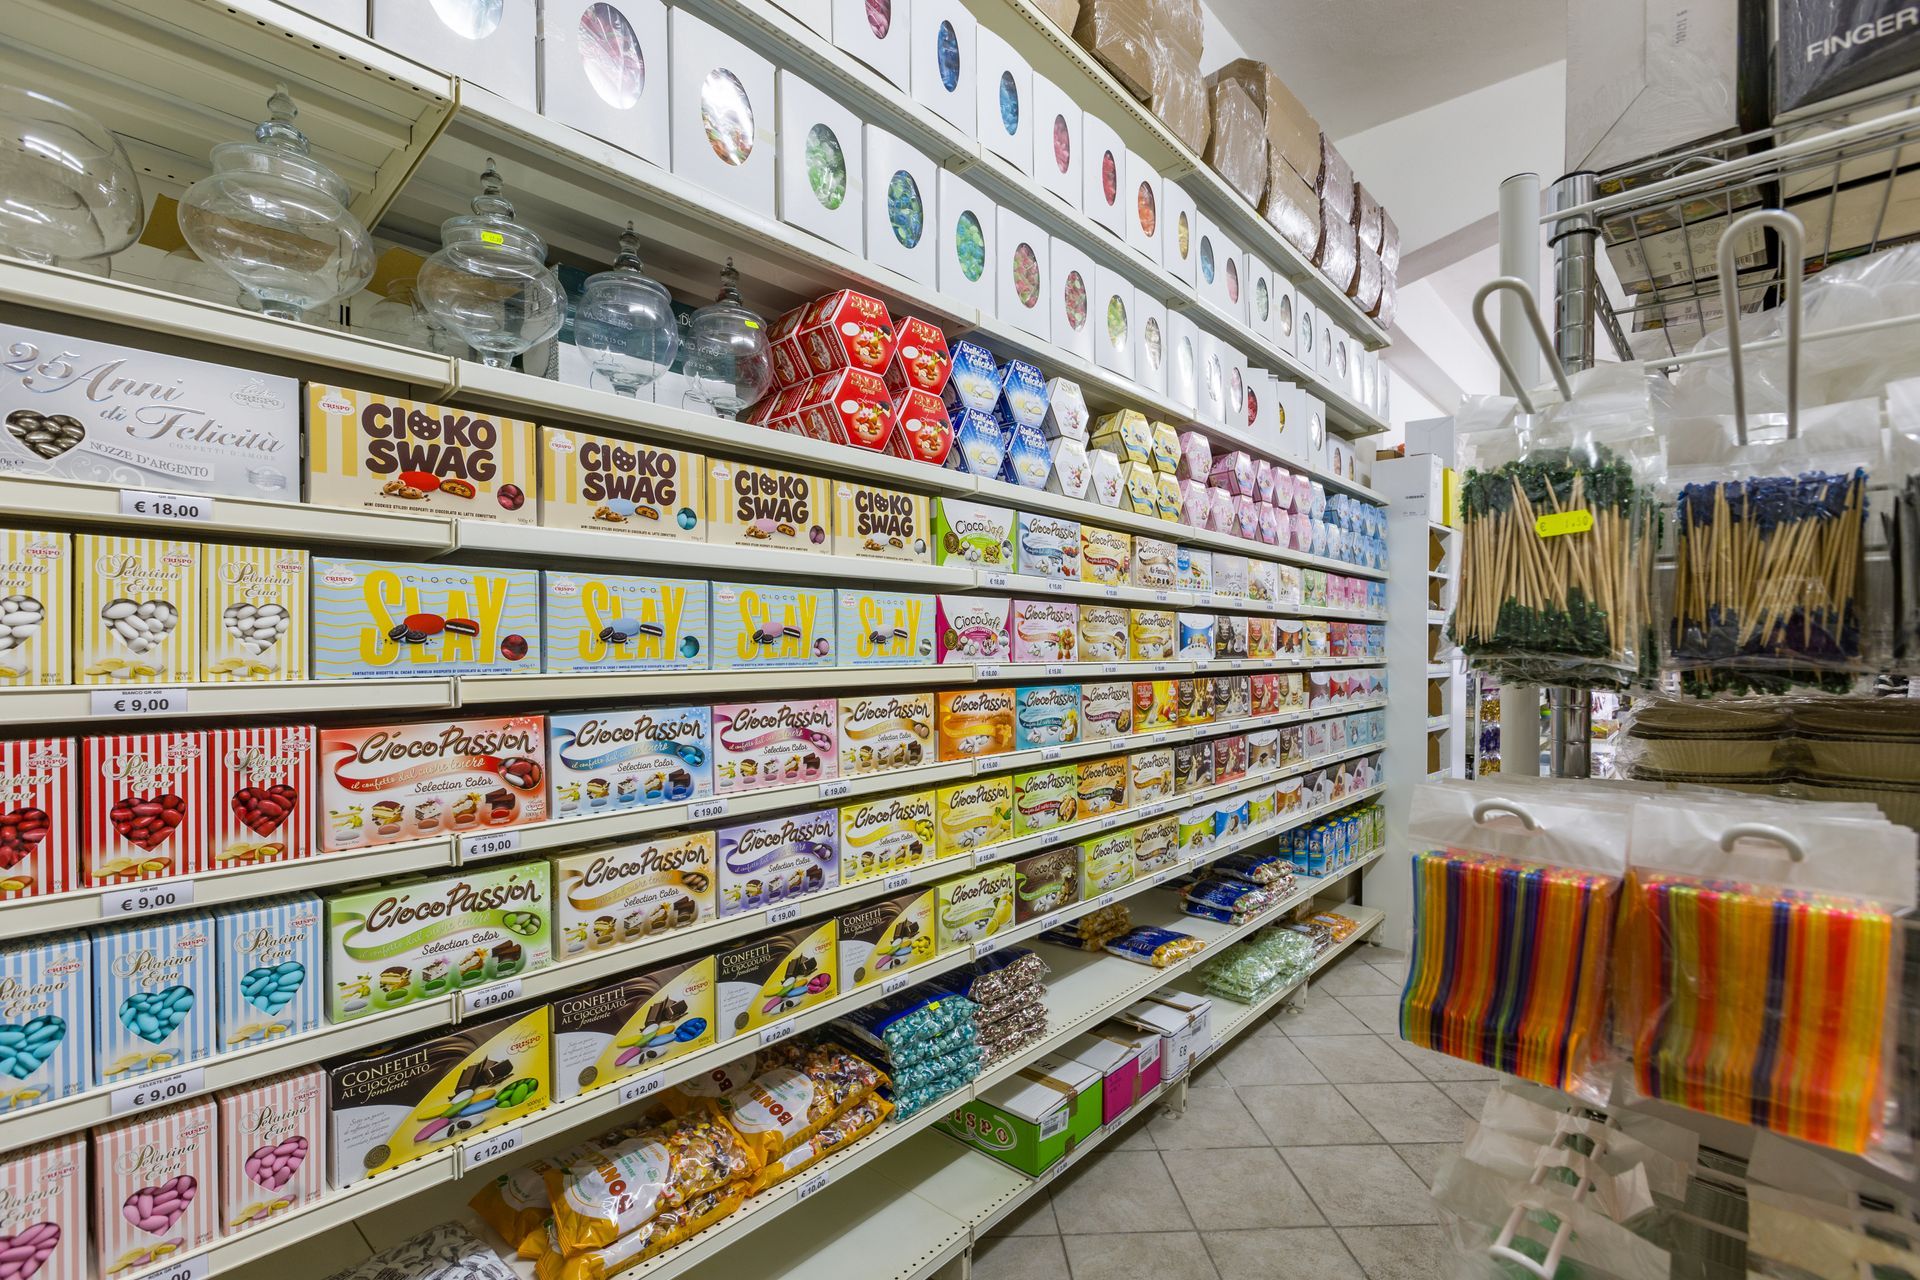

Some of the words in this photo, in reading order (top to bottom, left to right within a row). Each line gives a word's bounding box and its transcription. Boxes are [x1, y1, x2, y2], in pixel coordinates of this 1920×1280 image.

[1807, 7, 1919, 62] FINGER
[2, 342, 80, 379] 25
[22, 358, 185, 402] Anni
[322, 402, 350, 411] CRISPO
[100, 404, 127, 422] di
[126, 404, 285, 453] Felicità
[361, 403, 497, 450] CIOKO
[90, 440, 133, 461] NOZZE
[136, 453, 209, 478] D'ARGENTO
[365, 439, 497, 482] SWAG
[580, 442, 677, 479] CIOKO
[582, 472, 677, 506] SWAG
[734, 470, 809, 500] CIOKO
[134, 501, 146, 513] €
[152, 502, 199, 518] 18,00
[736, 496, 809, 524] SWAG
[855, 490, 914, 517] CIOKO
[857, 513, 914, 537] SWAG
[1029, 517, 1079, 542] CiocoPassion
[1089, 531, 1129, 551] CiocoPassion
[97, 554, 180, 579] Pelatina
[219, 561, 291, 585] Pelatina
[117, 580, 165, 592] Etna
[406, 575, 468, 585] CIOCO
[244, 585, 278, 597] Etna
[360, 570, 508, 666] SLAY
[578, 581, 687, 662] SLAY
[954, 612, 1001, 630] CiocoSoft
[1024, 604, 1076, 625] CiocoPassion
[1087, 608, 1127, 627] CiocoPassion
[1139, 610, 1174, 627] CiocoPassion
[737, 589, 817, 661] SLAY
[857, 596, 921, 658] SLAY
[1026, 688, 1079, 707] CiocoPassion
[1090, 683, 1130, 701] CiocoPassion
[114, 700, 126, 712] €
[131, 699, 170, 714] 9,00
[854, 698, 930, 722] CiocoPassion
[952, 693, 1013, 712] CiocoPassion
[733, 704, 831, 731] CiocoPassion
[576, 714, 704, 747] CiocoPassion
[358, 724, 536, 764] CiocoPassion
[764, 744, 790, 755] Selection
[791, 742, 808, 751] Color
[102, 753, 187, 780] Pelatina
[225, 746, 299, 771] Pelatina
[617, 761, 652, 772] Selection
[654, 759, 674, 768] Color
[1137, 752, 1171, 771] CiocoPassion
[250, 771, 286, 782] Etna
[1082, 761, 1126, 781] CiocoPassion
[131, 780, 172, 792] Etna
[362, 775, 397, 791] confetto
[415, 780, 462, 793] Selection
[465, 776, 493, 788] Color
[830, 786, 847, 795] 19,00
[1024, 772, 1076, 793] CiocoPassion
[950, 784, 1010, 809] CiocoPassion
[702, 806, 723, 817] 19,00
[854, 798, 932, 828] CiocoPassion
[738, 816, 834, 854] CiocoPassion
[1140, 821, 1178, 844] CiocoPassion
[471, 845, 478, 854] €
[482, 840, 511, 852] 19,00
[1092, 837, 1133, 860] CiocoPassion
[584, 841, 709, 887] CiocoPassion
[769, 862, 794, 873] Selection
[796, 857, 811, 868] Color
[894, 878, 908, 888] 19,00
[951, 872, 1014, 905] CiocoPassion
[121, 899, 133, 911] €
[138, 893, 176, 911] 9,00
[366, 874, 542, 932] CiocoPassion
[624, 894, 657, 908] Selection
[660, 888, 679, 900] Color
[292, 917, 317, 927] CRISPO
[778, 909, 796, 921] 19,00
[843, 908, 881, 926] CONFETTI
[851, 918, 882, 933] CIOCCOLATO
[177, 937, 207, 949] CRISPO
[235, 927, 306, 954] Pelatina
[422, 939, 469, 956] Selection
[472, 931, 500, 944] Color
[112, 950, 195, 978] Pelatina
[260, 949, 292, 963] Etna
[722, 943, 770, 966] CONFETTI
[47, 963, 80, 975] CRISPO
[722, 968, 731, 976] AL
[731, 955, 771, 973] CIOCCOLATO
[735, 966, 759, 980] fondente
[141, 972, 179, 987] Etna
[685, 980, 710, 993] CRISPO
[892, 980, 906, 990] 12,00
[5, 1000, 49, 1018] Etna
[474, 999, 481, 1008] €
[485, 990, 514, 1004] 19,00
[562, 986, 625, 1015] CONFETTI
[561, 1016, 572, 1025] AL
[573, 1000, 627, 1021] CIOCCOLATO
[576, 1011, 612, 1030] fondente
[510, 1035, 541, 1051] CRISPO
[772, 1028, 791, 1039] 12,00
[342, 1049, 429, 1087] CONFETTI
[139, 1080, 162, 1089] CELESTE
[342, 1089, 356, 1099] AL
[358, 1064, 430, 1094] CIOCCOLATO
[626, 1090, 633, 1099] €
[635, 1081, 658, 1095] 12,00
[133, 1093, 145, 1106] €
[150, 1082, 188, 1101] 9,00
[295, 1090, 319, 1101] CRISPO
[361, 1080, 409, 1104] fondente
[241, 1104, 308, 1131] Pelatina
[180, 1125, 209, 1138] CRISPO
[265, 1123, 295, 1140] Etna
[116, 1144, 198, 1174] Pelatina
[474, 1152, 481, 1161] €
[485, 1139, 514, 1157] 12,00
[41, 1166, 76, 1181] CRISPO
[145, 1163, 181, 1181] Etna
[807, 1179, 826, 1194] 10,00
